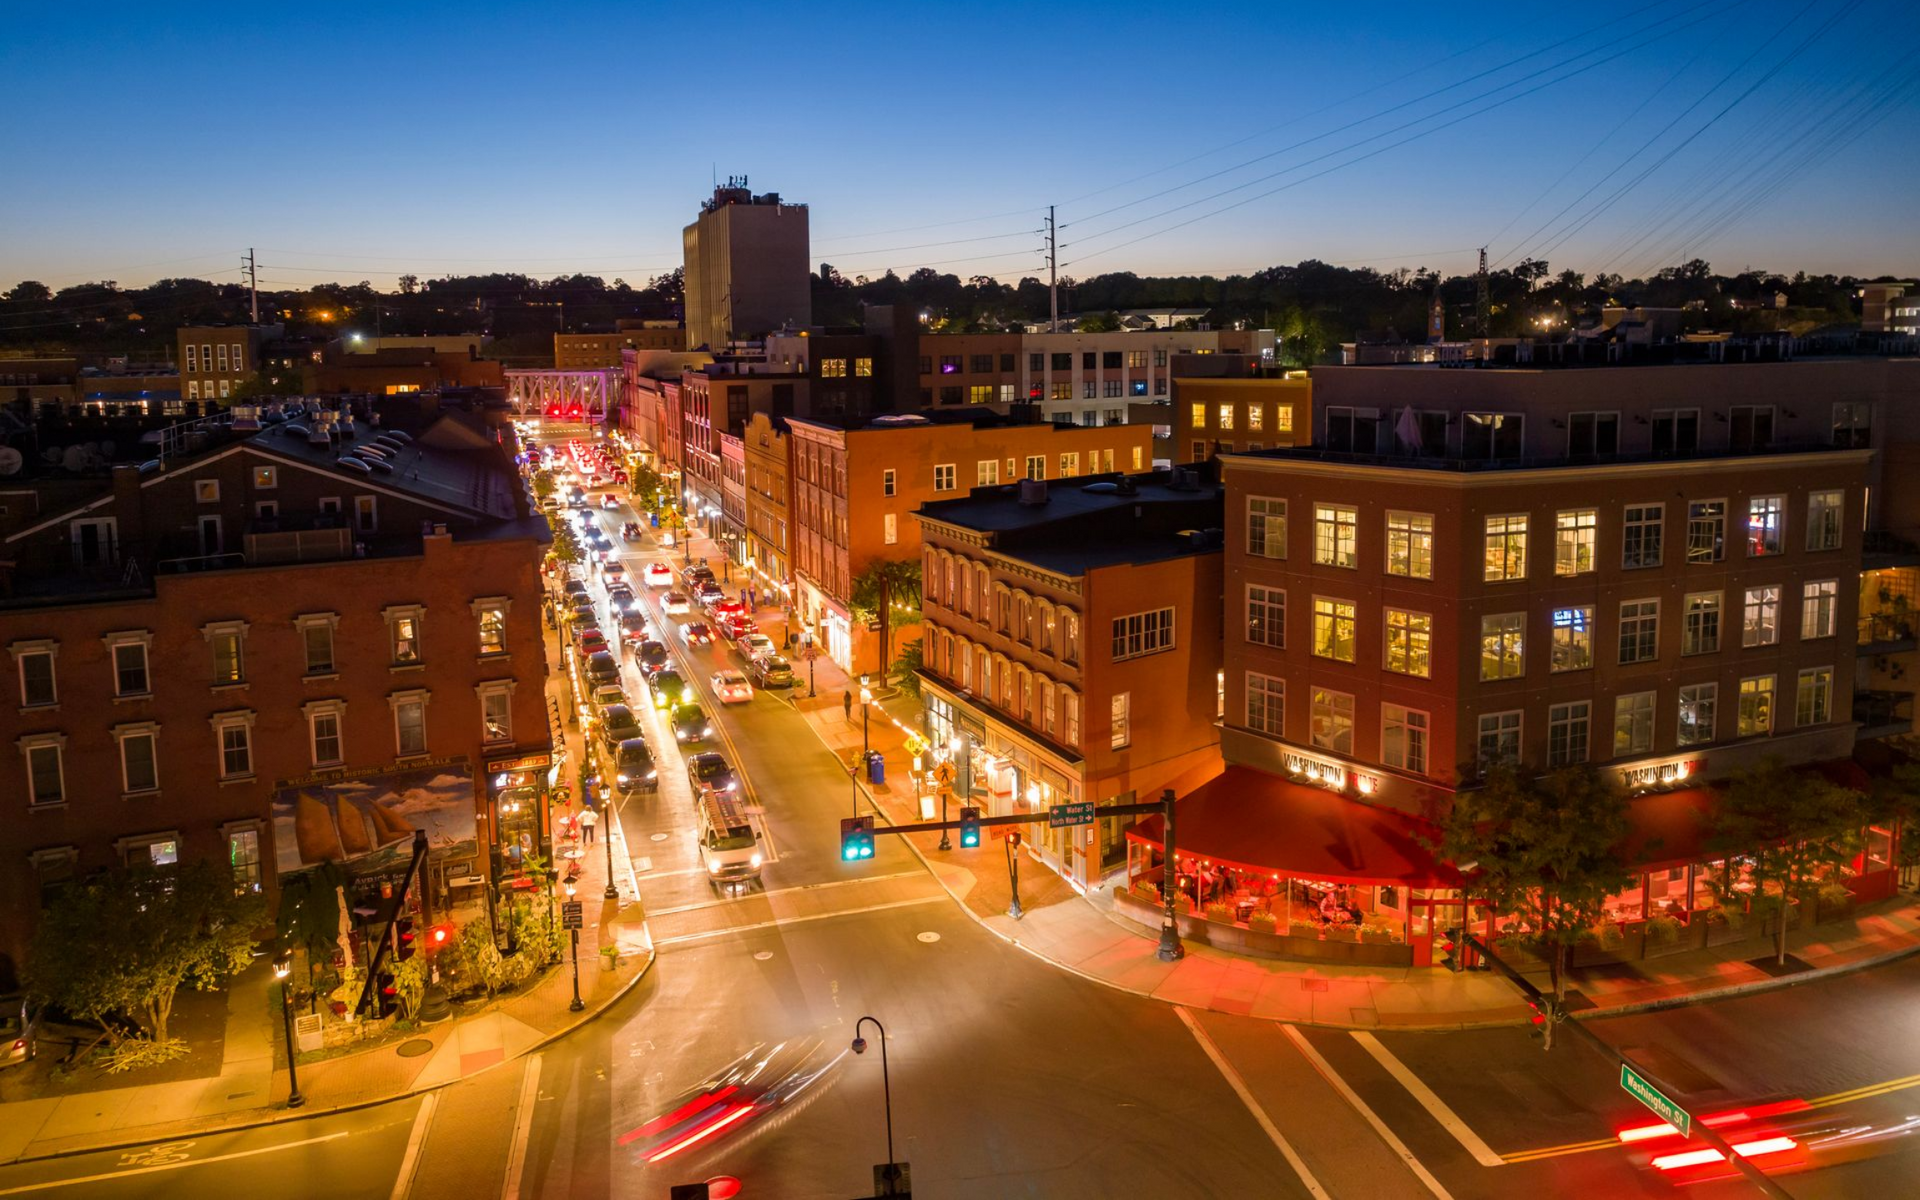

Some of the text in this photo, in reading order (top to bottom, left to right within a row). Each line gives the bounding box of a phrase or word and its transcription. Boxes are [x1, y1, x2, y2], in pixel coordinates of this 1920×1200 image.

[287, 774, 328, 786] WELCOME
[332, 772, 341, 780] TO
[411, 757, 451, 769] NORWALK
[1283, 753, 1341, 782] WASHINGTON
[1625, 763, 1678, 787] WASHINGTON
[1051, 817, 1065, 826] North
[1066, 816, 1078, 824] Water
[1066, 804, 1093, 814] Water St
[1627, 1073, 1684, 1127] Washington St
